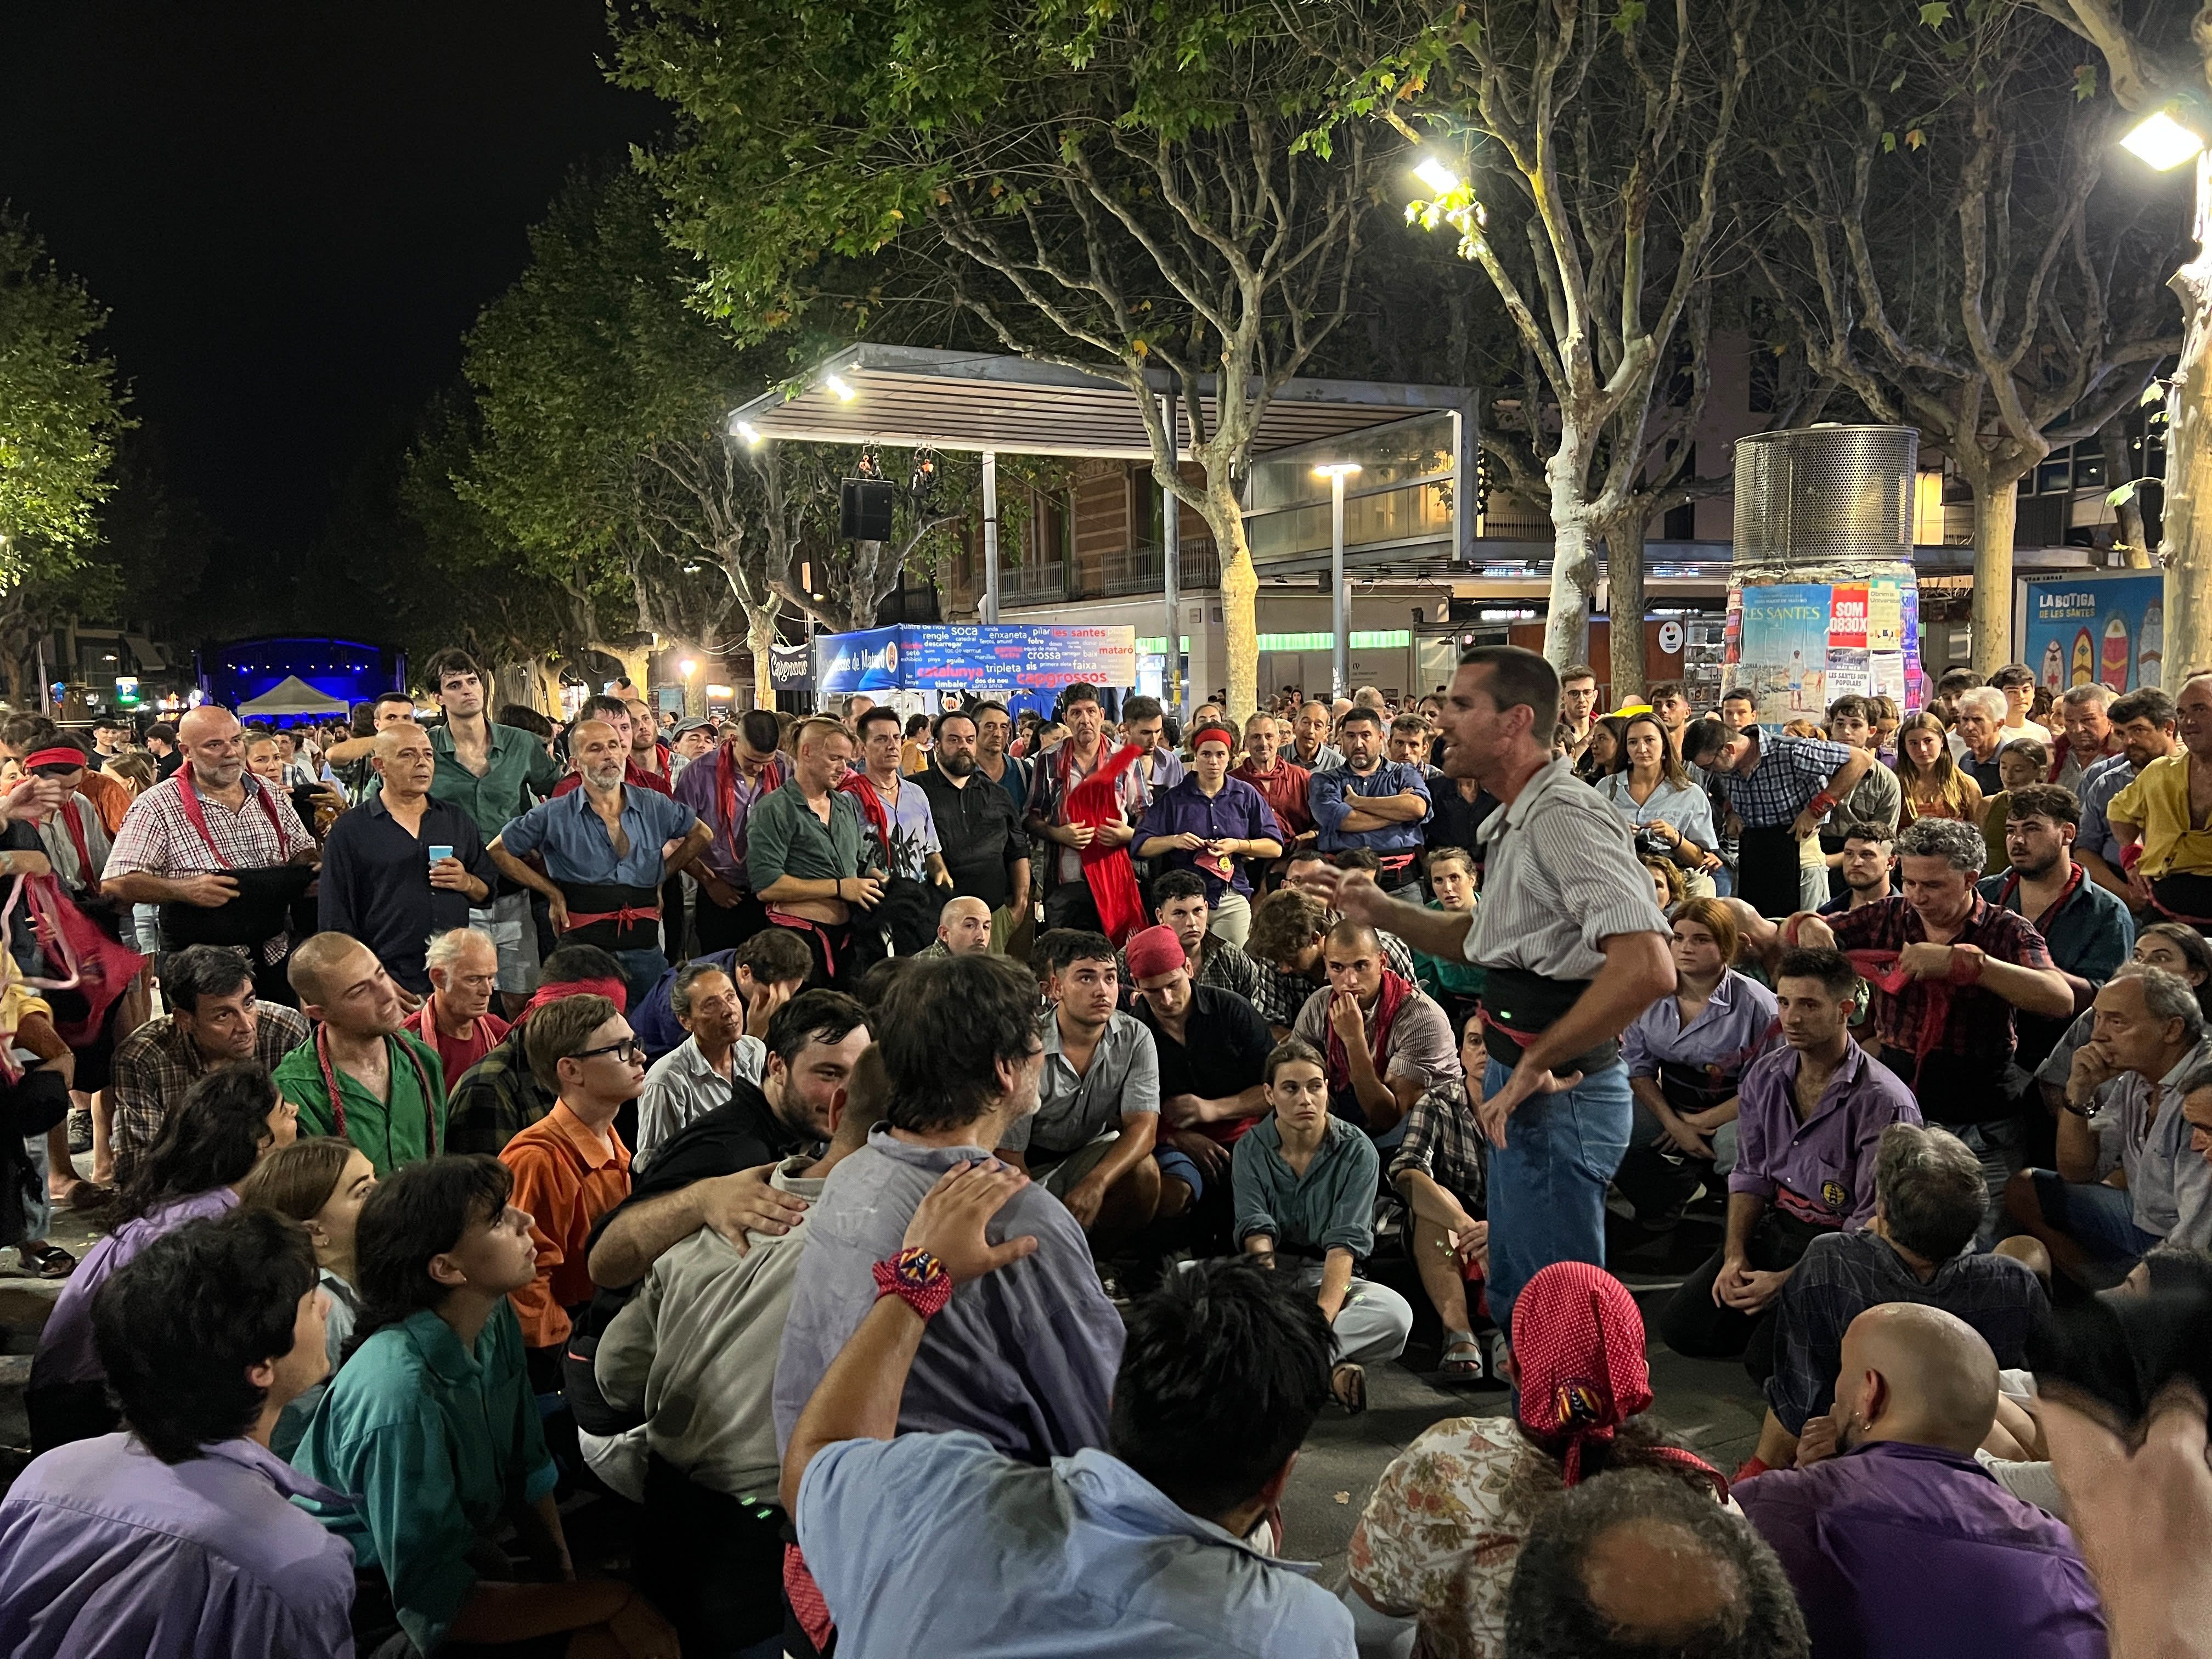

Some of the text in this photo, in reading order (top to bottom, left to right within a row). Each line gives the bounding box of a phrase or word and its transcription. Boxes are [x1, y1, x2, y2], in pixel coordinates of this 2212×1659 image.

[2040, 592, 2095, 608] LA BOTIGA
[1745, 606, 1820, 620] LES SANTES
[1836, 602, 1864, 617] SOM
[2039, 608, 2095, 618] DE LES SANTES
[923, 631, 949, 641] rengle
[951, 627, 978, 636] soca
[1032, 627, 1051, 636] pilar
[1052, 628, 1068, 637] les
[1071, 628, 1106, 637] santes
[924, 640, 963, 648] descarregar
[1099, 645, 1133, 654] mataró
[1027, 652, 1061, 660] crossa
[852, 651, 860, 672] de
[1026, 661, 1037, 670] sis
[1073, 659, 1097, 670] faixa
[917, 663, 984, 681] catalunya
[985, 662, 1022, 675] tripleta
[934, 680, 967, 688] timbaler
[1017, 673, 1107, 688] capgrossos
